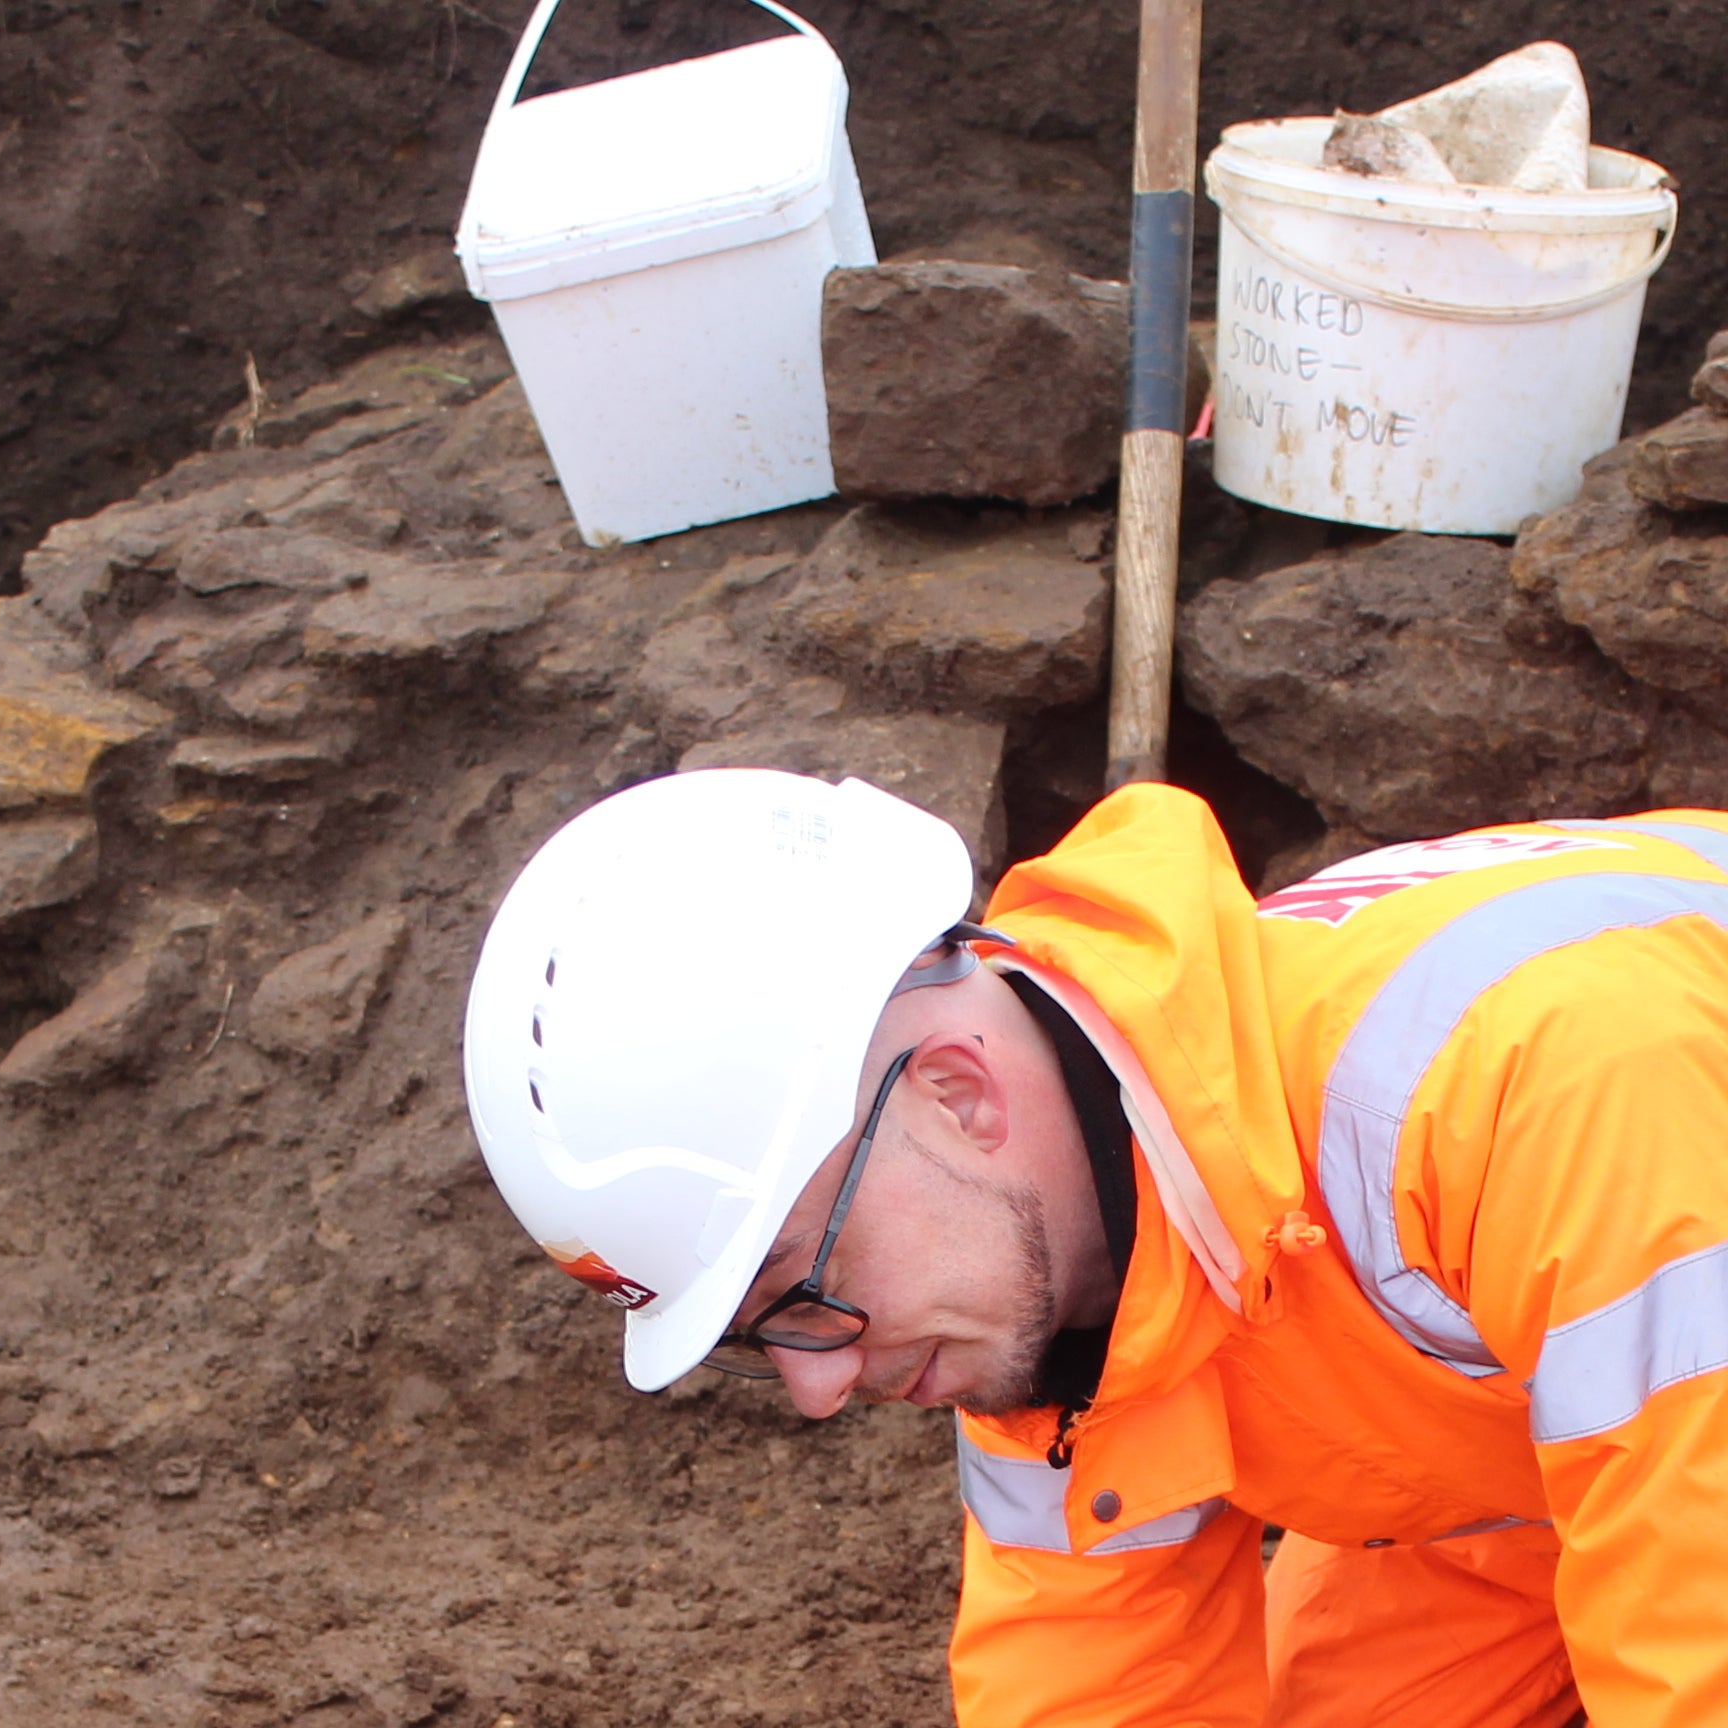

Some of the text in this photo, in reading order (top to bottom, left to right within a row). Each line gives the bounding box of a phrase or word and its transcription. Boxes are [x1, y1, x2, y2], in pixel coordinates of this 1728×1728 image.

[1234, 266, 1363, 336] WORKED
[1222, 371, 1417, 447] DON'T MOVE
[602, 1284, 649, 1308] OLA
